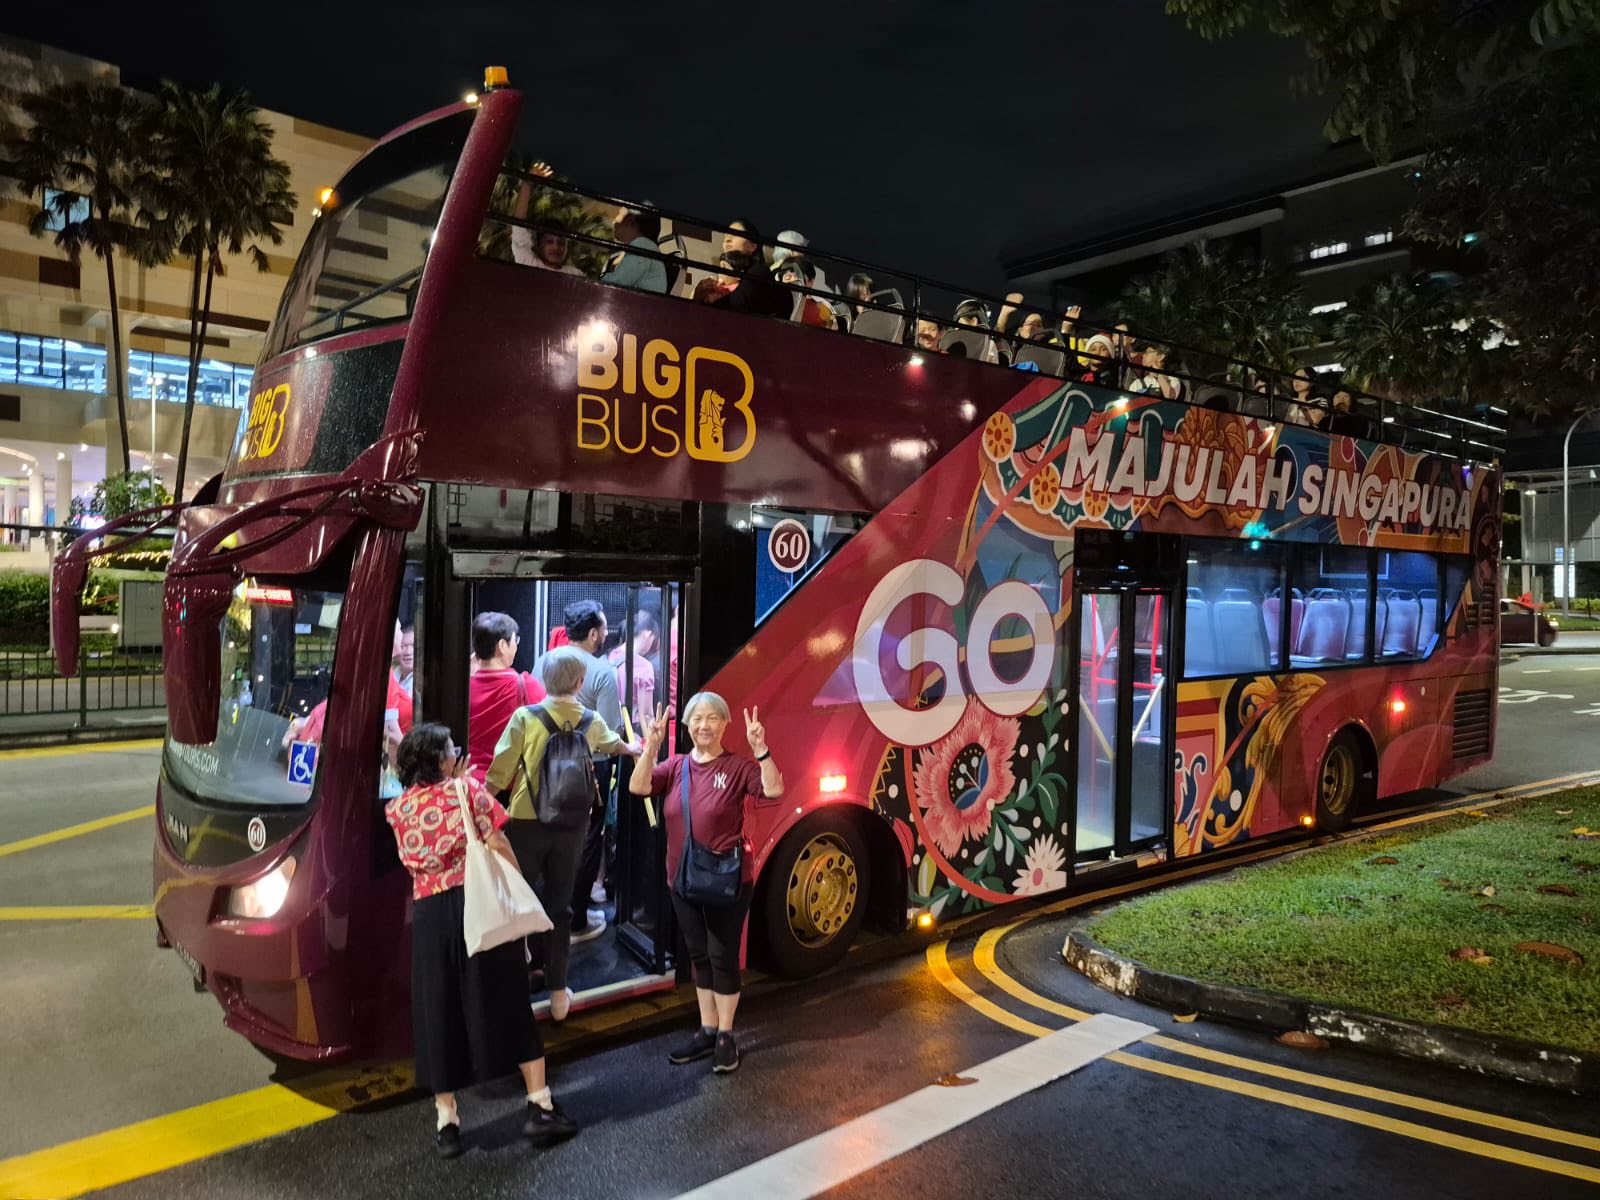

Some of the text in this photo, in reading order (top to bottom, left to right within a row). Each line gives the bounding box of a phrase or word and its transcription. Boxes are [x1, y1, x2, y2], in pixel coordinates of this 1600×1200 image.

[577, 318, 681, 399] BIG
[248, 388, 272, 430] BIG
[577, 393, 681, 458] BUS
[685, 346, 757, 463] B
[1060, 427, 1471, 530] MAJULAH SINGAPURA
[775, 531, 803, 560] 60
